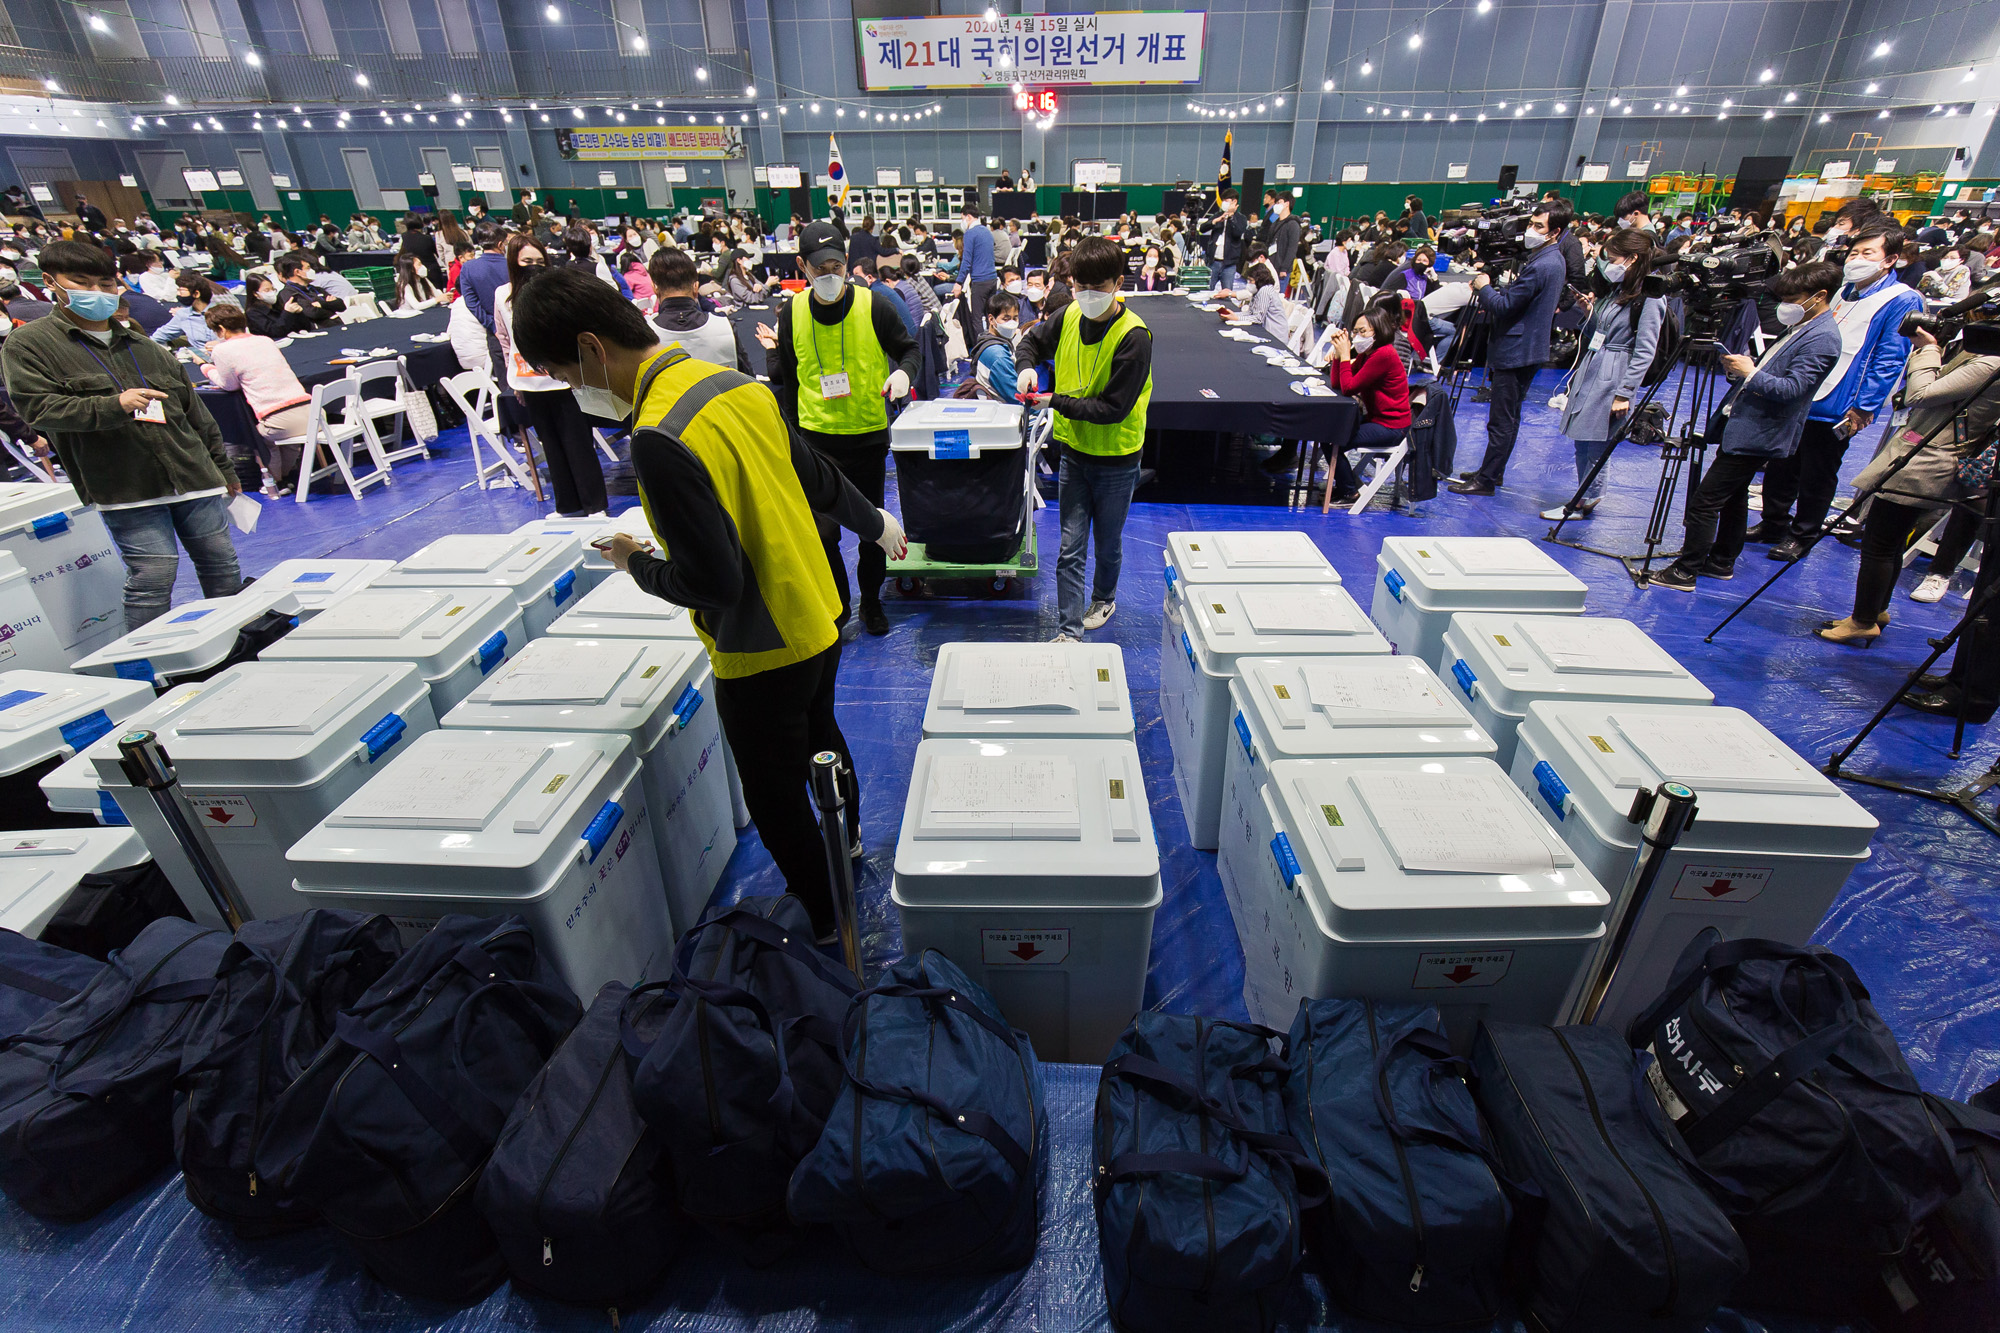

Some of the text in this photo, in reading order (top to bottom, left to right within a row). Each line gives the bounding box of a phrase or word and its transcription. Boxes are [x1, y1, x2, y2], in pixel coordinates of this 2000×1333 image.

[965, 16, 1098, 34] 2020년 4월 15일 실시
[878, 32, 1186, 70] 제21대 국회의원선거 개표
[569, 132, 600, 149] 배드민턴
[667, 132, 697, 148] 배드민턴
[698, 132, 728, 148] 필라테스
[30, 548, 112, 585] 주주의 꽃은 선거입니다
[565, 806, 647, 930] 민주주의 꽃은 선거입니다
[1745, 872, 1764, 880] 주세요
[1665, 1016, 1724, 1095] 선거사무
